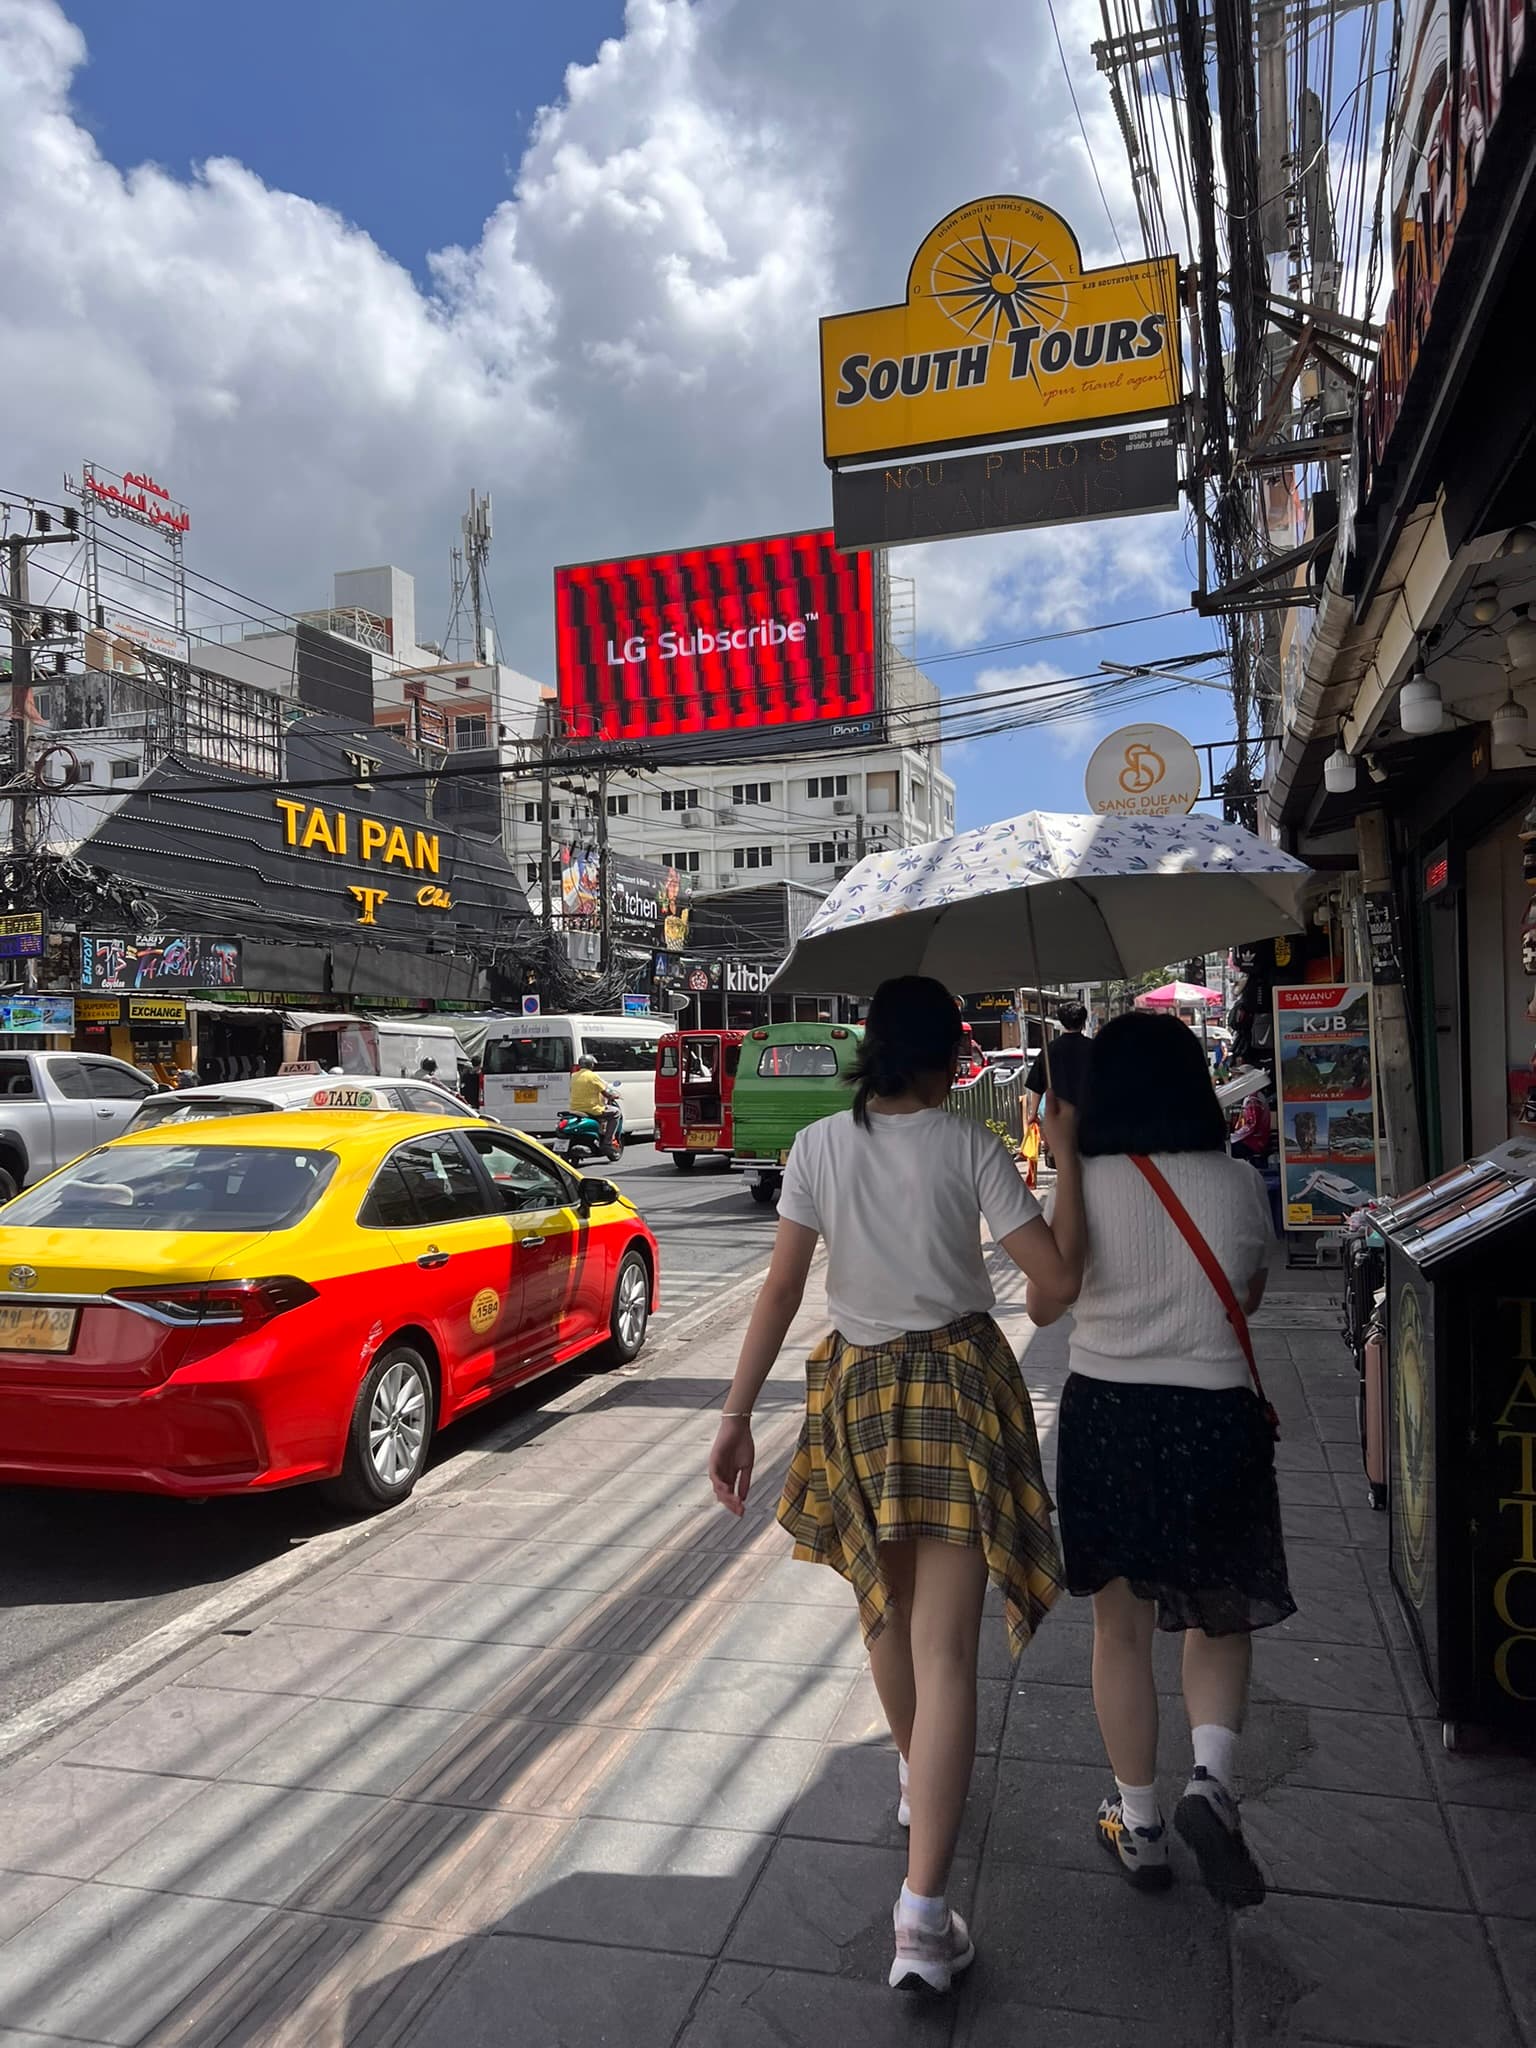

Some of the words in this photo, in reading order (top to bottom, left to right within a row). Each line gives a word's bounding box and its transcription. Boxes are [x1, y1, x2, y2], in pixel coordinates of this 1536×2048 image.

[836, 344, 989, 406] SOUTH
[1008, 313, 1167, 381] TOURS
[1044, 386, 1077, 406] your
[1081, 373, 1124, 392] travel
[1127, 368, 1171, 390] agent
[607, 636, 647, 666] LG
[1098, 797, 1136, 811] SANG
[1140, 792, 1189, 808] DUEAN
[276, 798, 347, 856] TAI
[361, 818, 440, 874] PAN
[1285, 991, 1333, 1001] SAWANU
[131, 1006, 182, 1018] EXCHANGE
[1303, 1016, 1347, 1032] KJB
[284, 1063, 311, 1073] TAXI
[329, 1090, 359, 1106] TAXI
[477, 1301, 498, 1319] 1584
[32, 1310, 70, 1331] 1723
